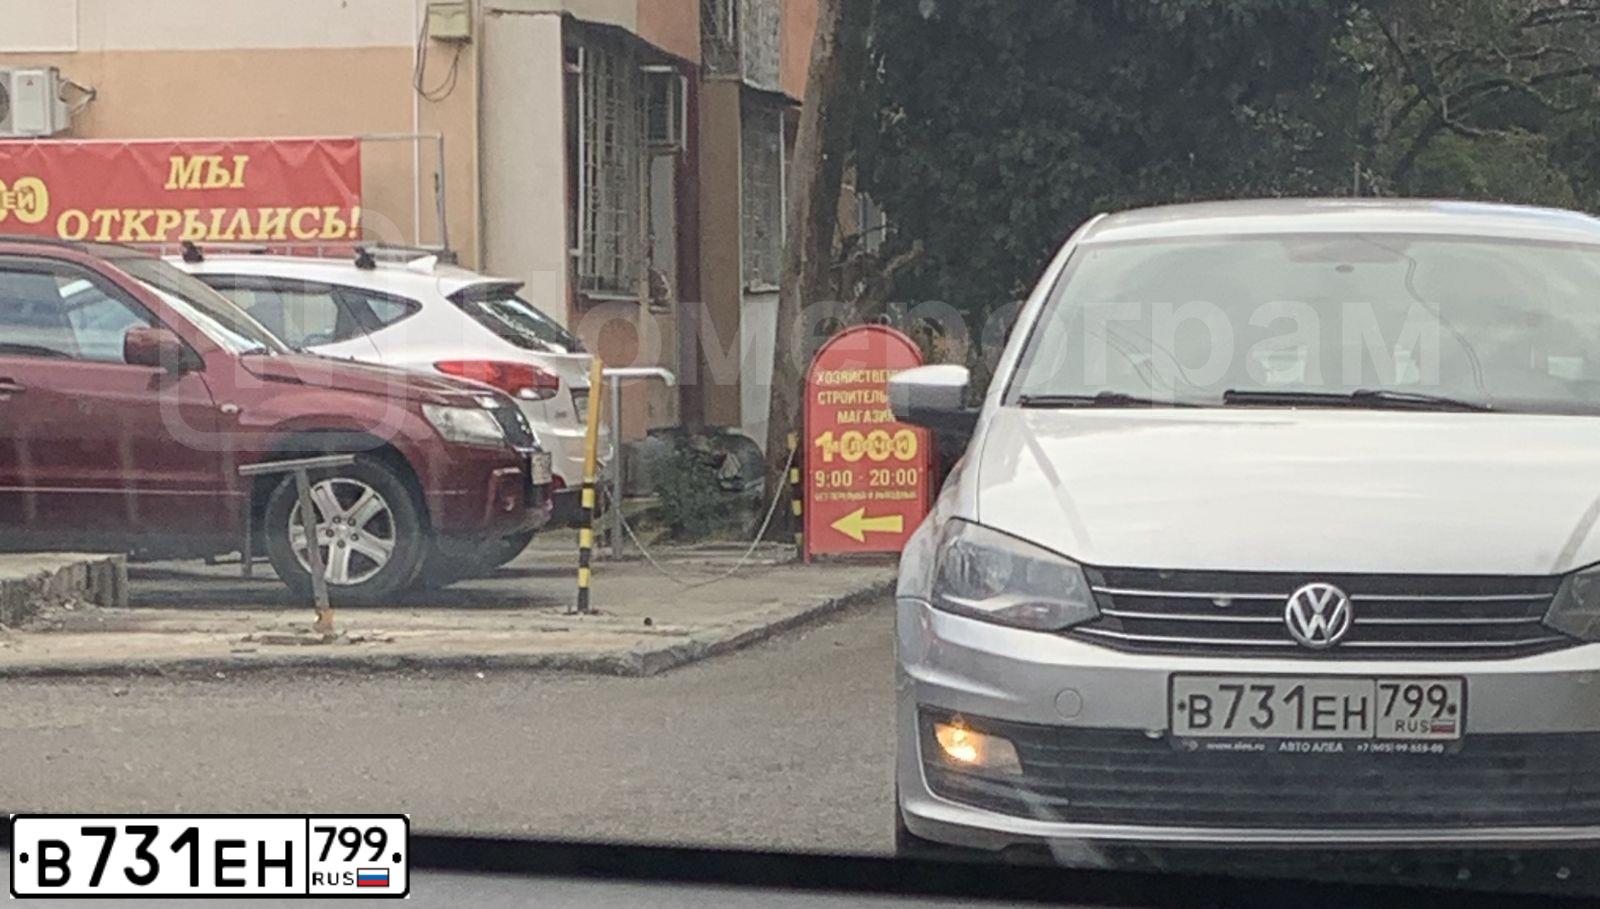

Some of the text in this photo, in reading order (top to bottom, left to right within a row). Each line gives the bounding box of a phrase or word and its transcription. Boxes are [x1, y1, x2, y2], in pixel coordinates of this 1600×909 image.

[165, 155, 249, 190] МЫ
[57, 205, 361, 241] ОТКРЫЛИСЬ!
[815, 429, 917, 462] 1000
[815, 470, 853, 488] 9:00
[869, 468, 917, 487] 20:00
[1188, 684, 1447, 731] В731ЕН 799
[1395, 719, 1429, 733] RUS
[1279, 741, 1310, 753] АВТО
